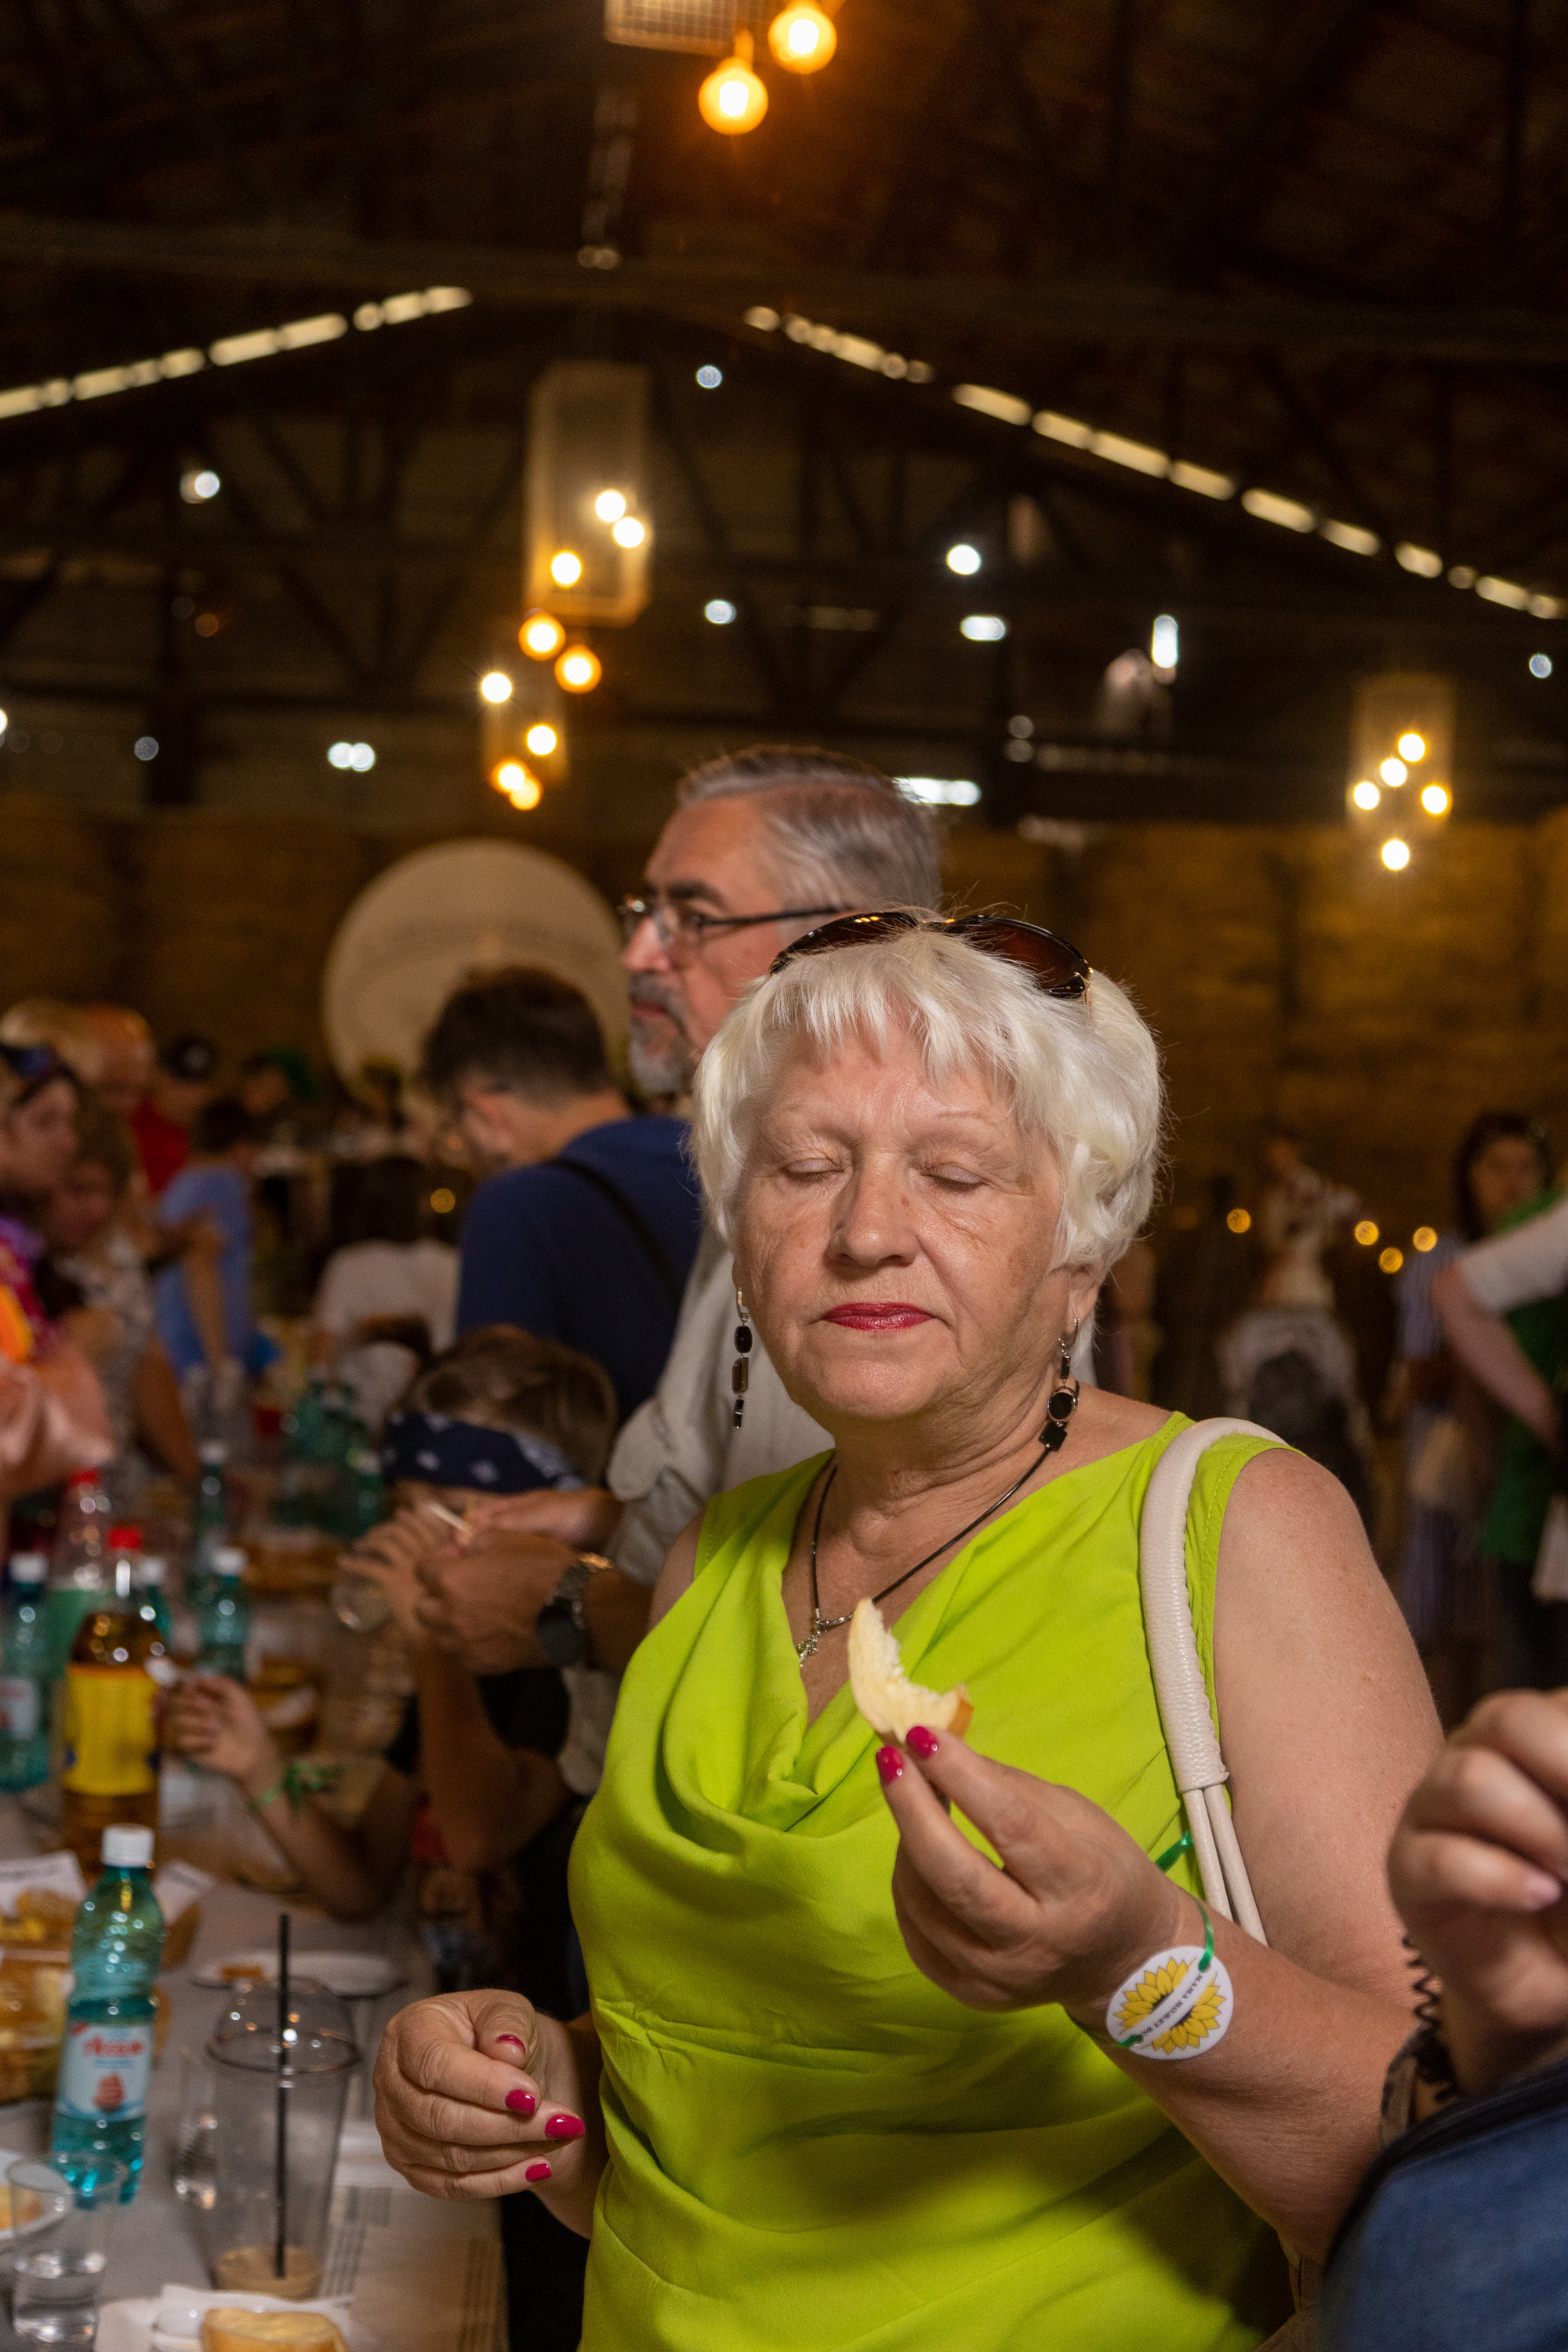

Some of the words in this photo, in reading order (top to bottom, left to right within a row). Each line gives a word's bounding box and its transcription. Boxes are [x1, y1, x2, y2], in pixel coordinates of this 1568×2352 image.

[1182, 1974, 1203, 1998] МАМА
[1154, 2000, 1183, 2027] МОЖЕТ
[1141, 2027, 1153, 2036] ВС
